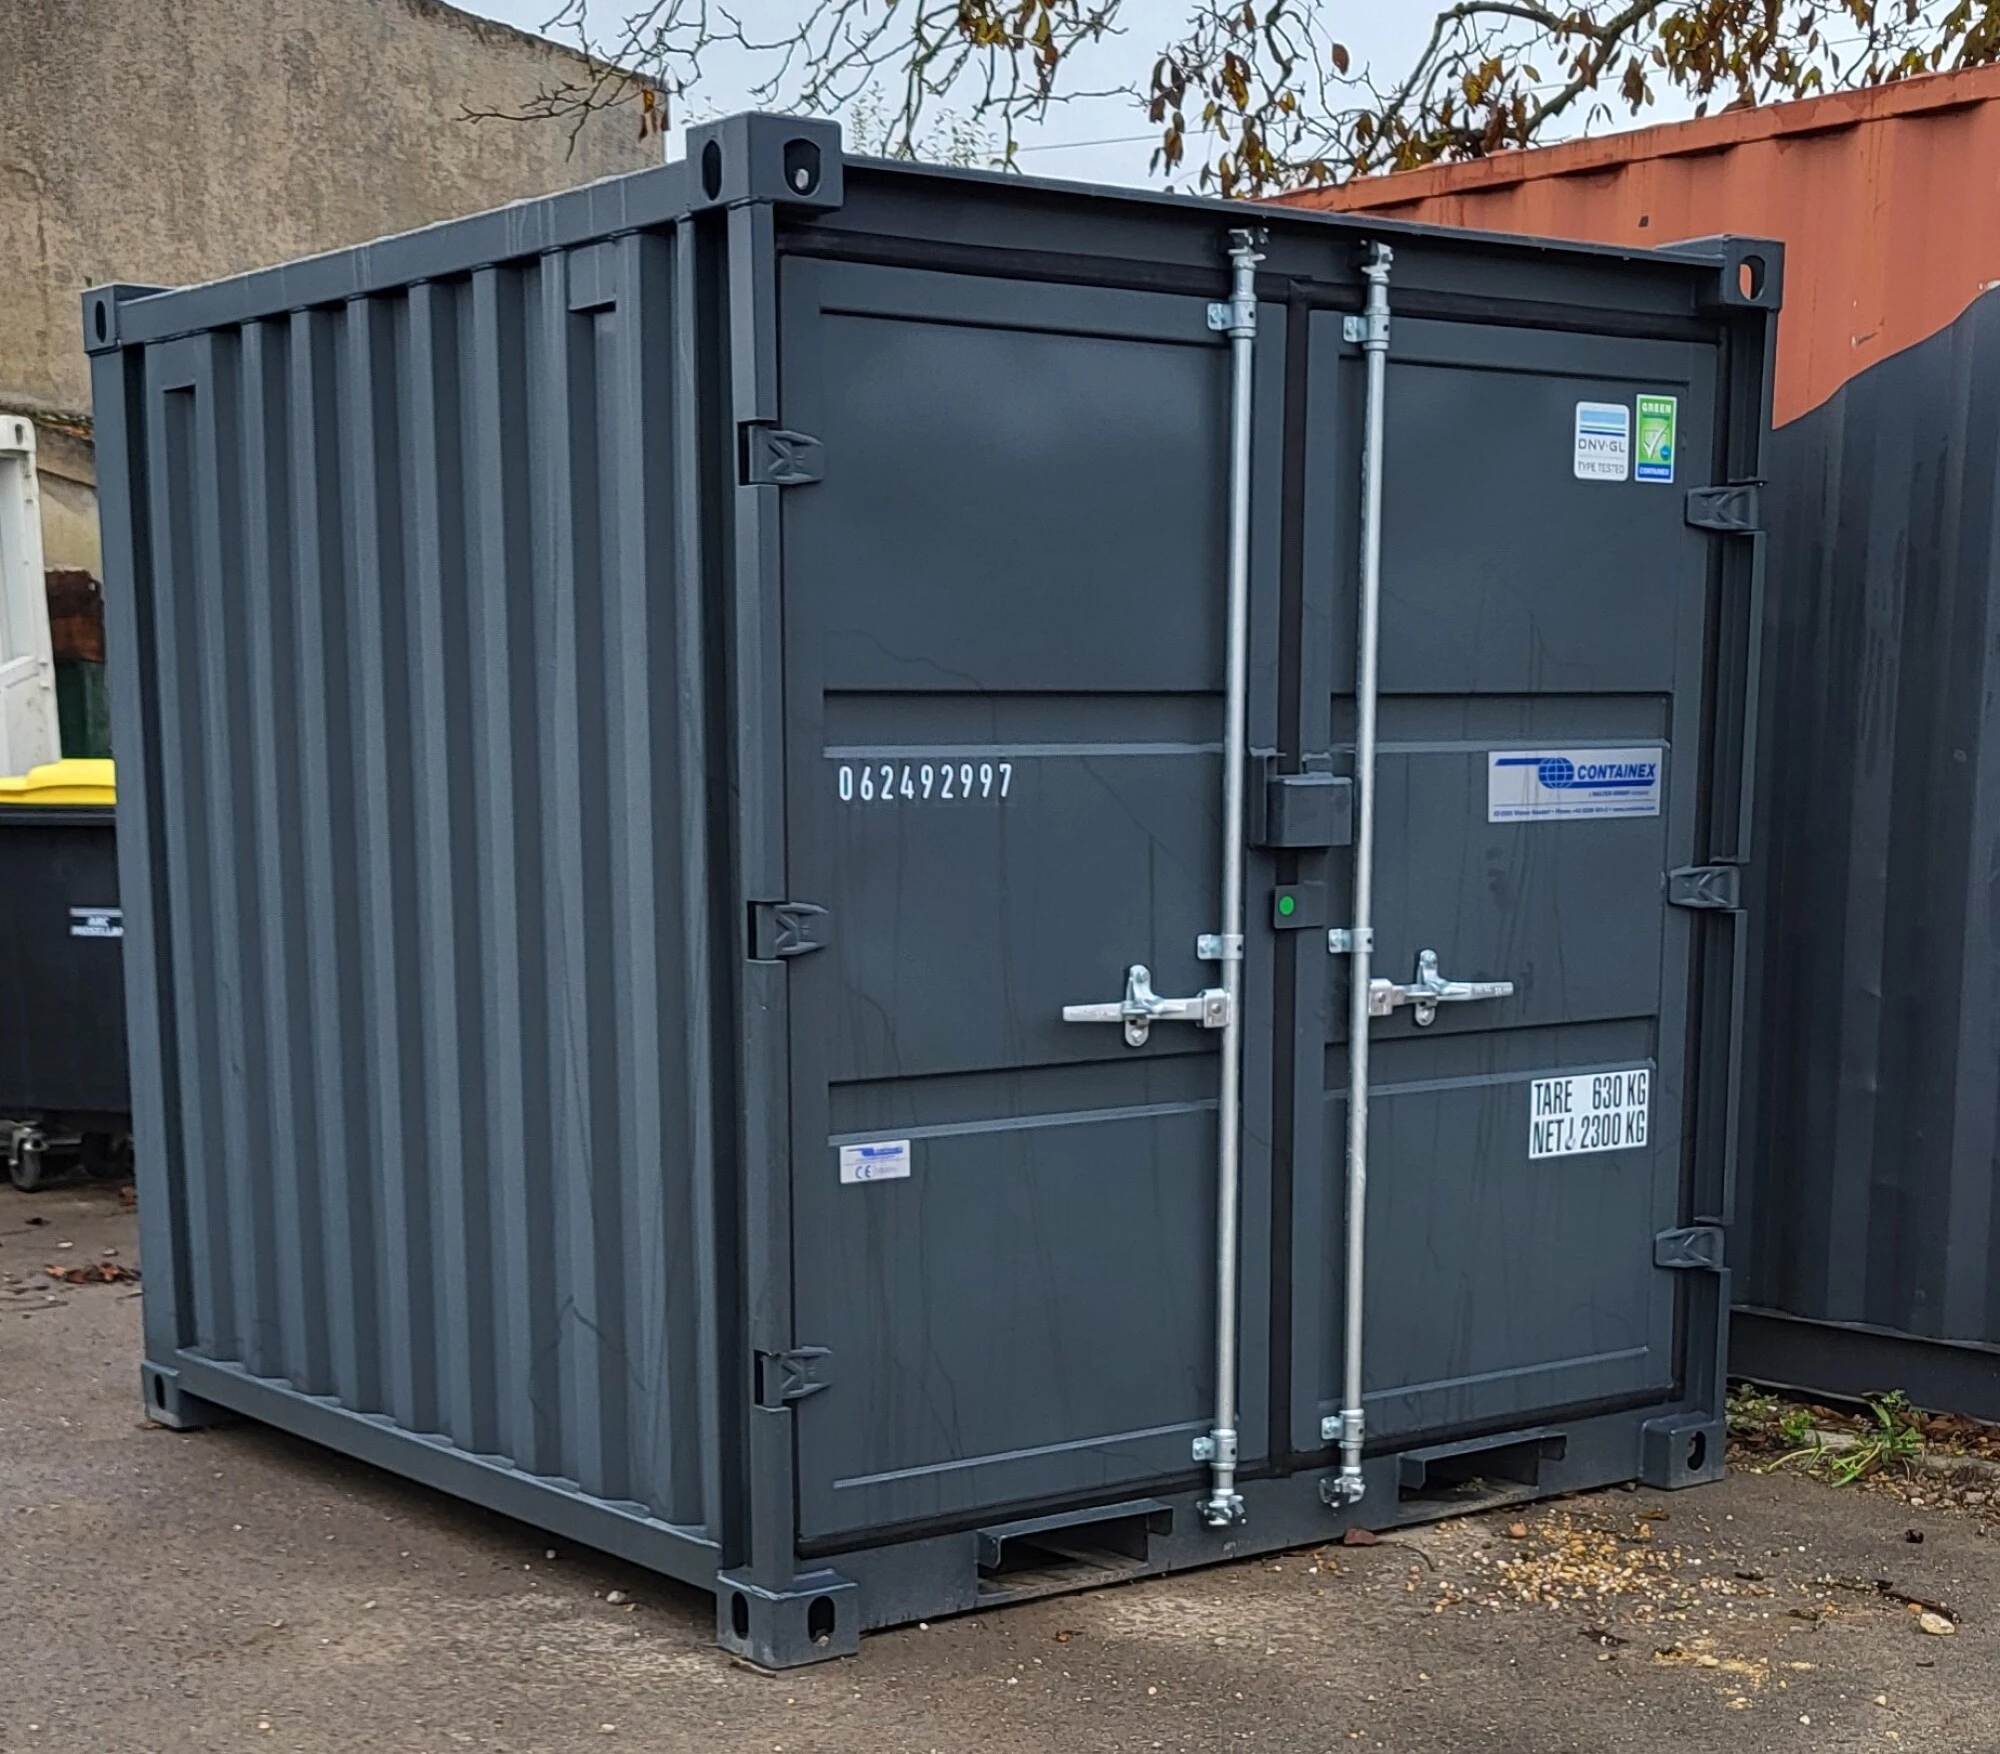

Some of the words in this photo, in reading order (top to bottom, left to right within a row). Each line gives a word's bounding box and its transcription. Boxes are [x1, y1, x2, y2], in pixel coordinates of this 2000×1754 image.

[1642, 402, 1671, 413] GREEN
[1578, 461, 1596, 472] TYPE
[1598, 462, 1625, 474] TESTED
[839, 763, 1012, 801] 062492997
[1577, 762, 1656, 780] CONTAINEX
[1534, 1080, 1572, 1116] TARE
[1592, 1075, 1622, 1110] 630
[1627, 1072, 1646, 1107] KG
[1532, 1118, 1564, 1154] NET
[1580, 1112, 1621, 1149] 2300
[1625, 1110, 1645, 1144] KG
